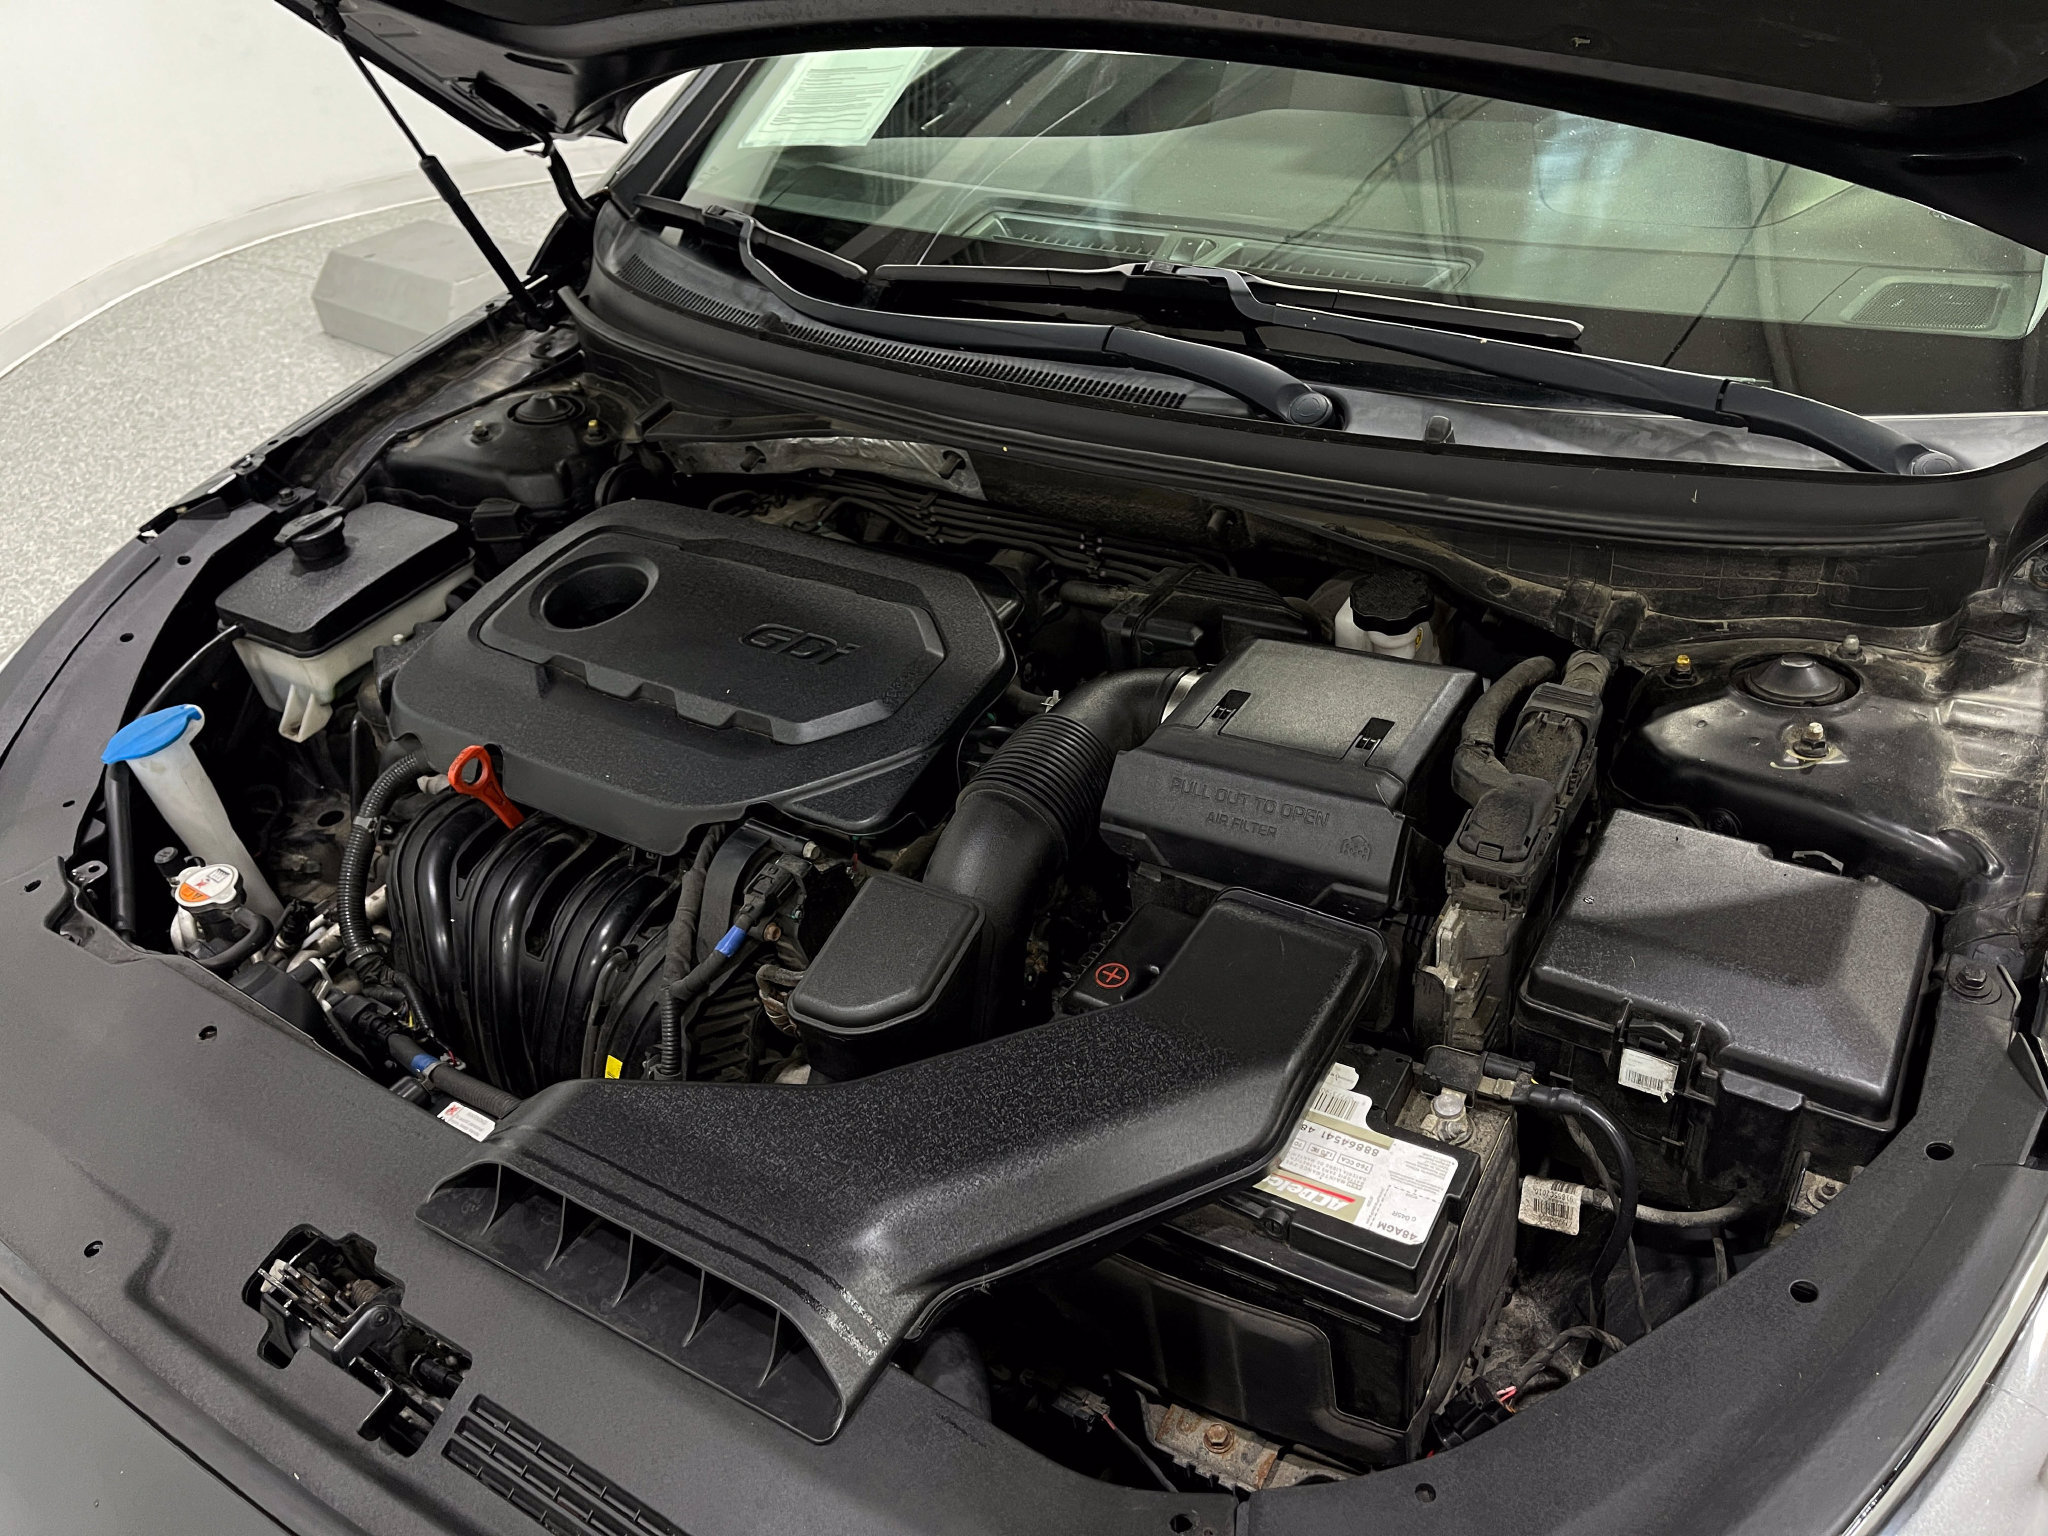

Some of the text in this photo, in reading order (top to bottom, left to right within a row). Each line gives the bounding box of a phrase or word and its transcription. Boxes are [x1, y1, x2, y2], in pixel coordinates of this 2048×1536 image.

[1170, 776, 1330, 828] PULL OUT TO OPEN
[1205, 811, 1278, 838] AIR FILTER
[1320, 1130, 1379, 1157] 88864541
[1340, 1156, 1354, 1166] CCA
[1376, 1220, 1416, 1240] 48AGM
